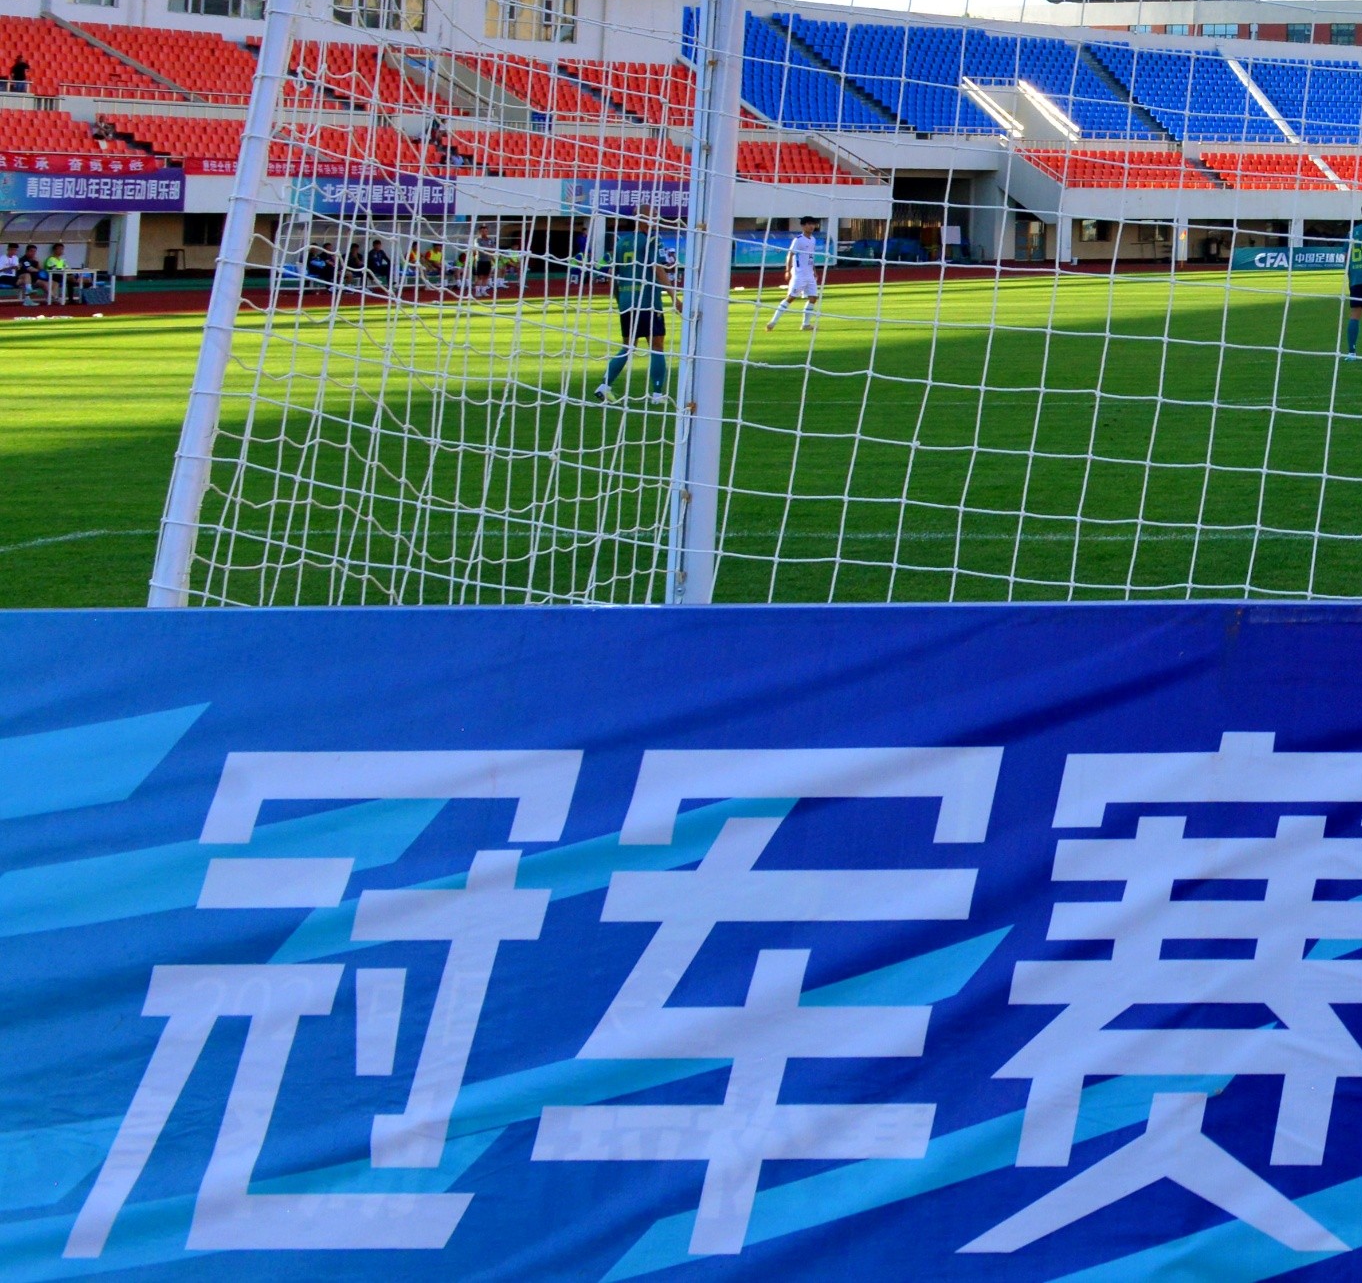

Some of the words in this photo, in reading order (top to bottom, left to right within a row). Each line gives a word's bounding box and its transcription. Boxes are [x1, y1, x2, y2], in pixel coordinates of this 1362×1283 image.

[26, 177, 181, 201] 青岛追风少年足球运动俱乐部
[1254, 252, 1289, 267] CFA
